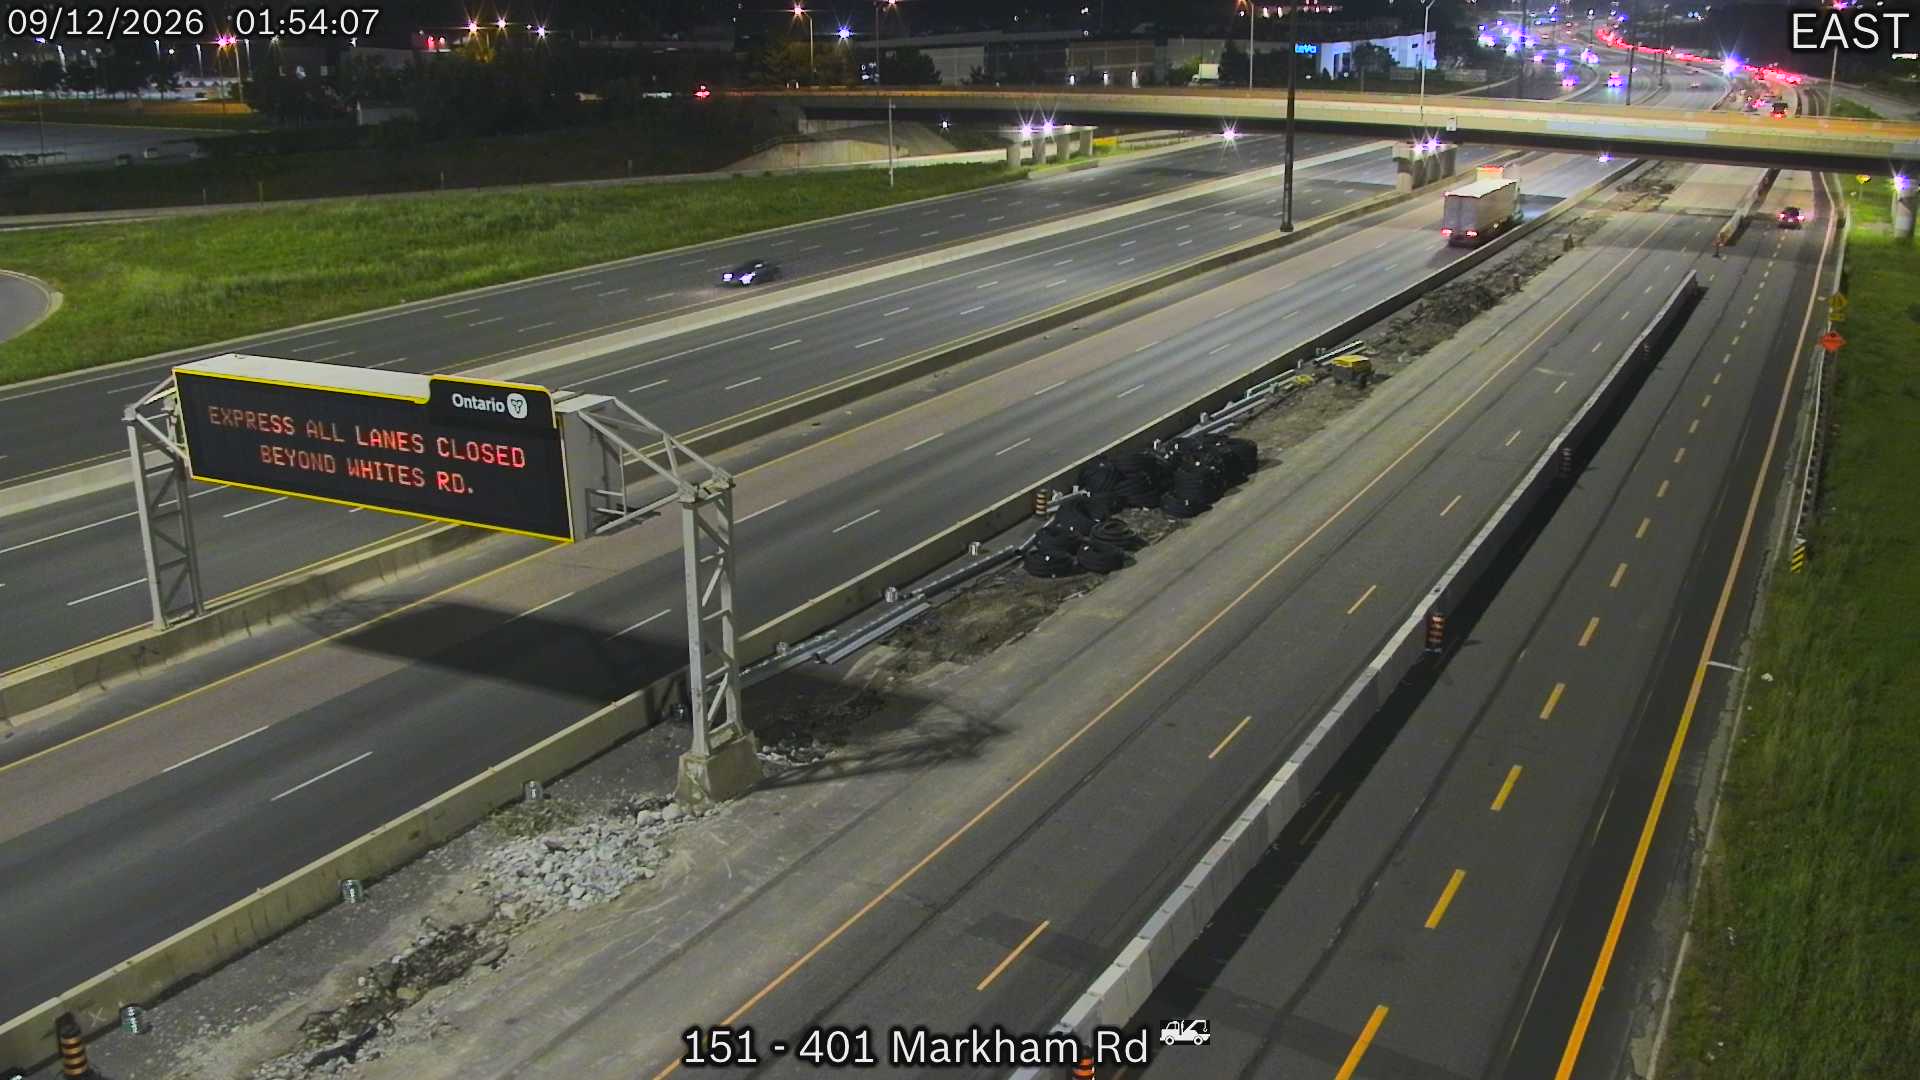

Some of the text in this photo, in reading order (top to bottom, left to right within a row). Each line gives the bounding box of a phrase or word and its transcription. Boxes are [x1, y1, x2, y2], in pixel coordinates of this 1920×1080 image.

[452, 393, 506, 413] Ontario
[208, 406, 526, 468] EXPRESS ALL LANES CLOSED
[259, 444, 474, 494] BEYOND WHITES RD.
